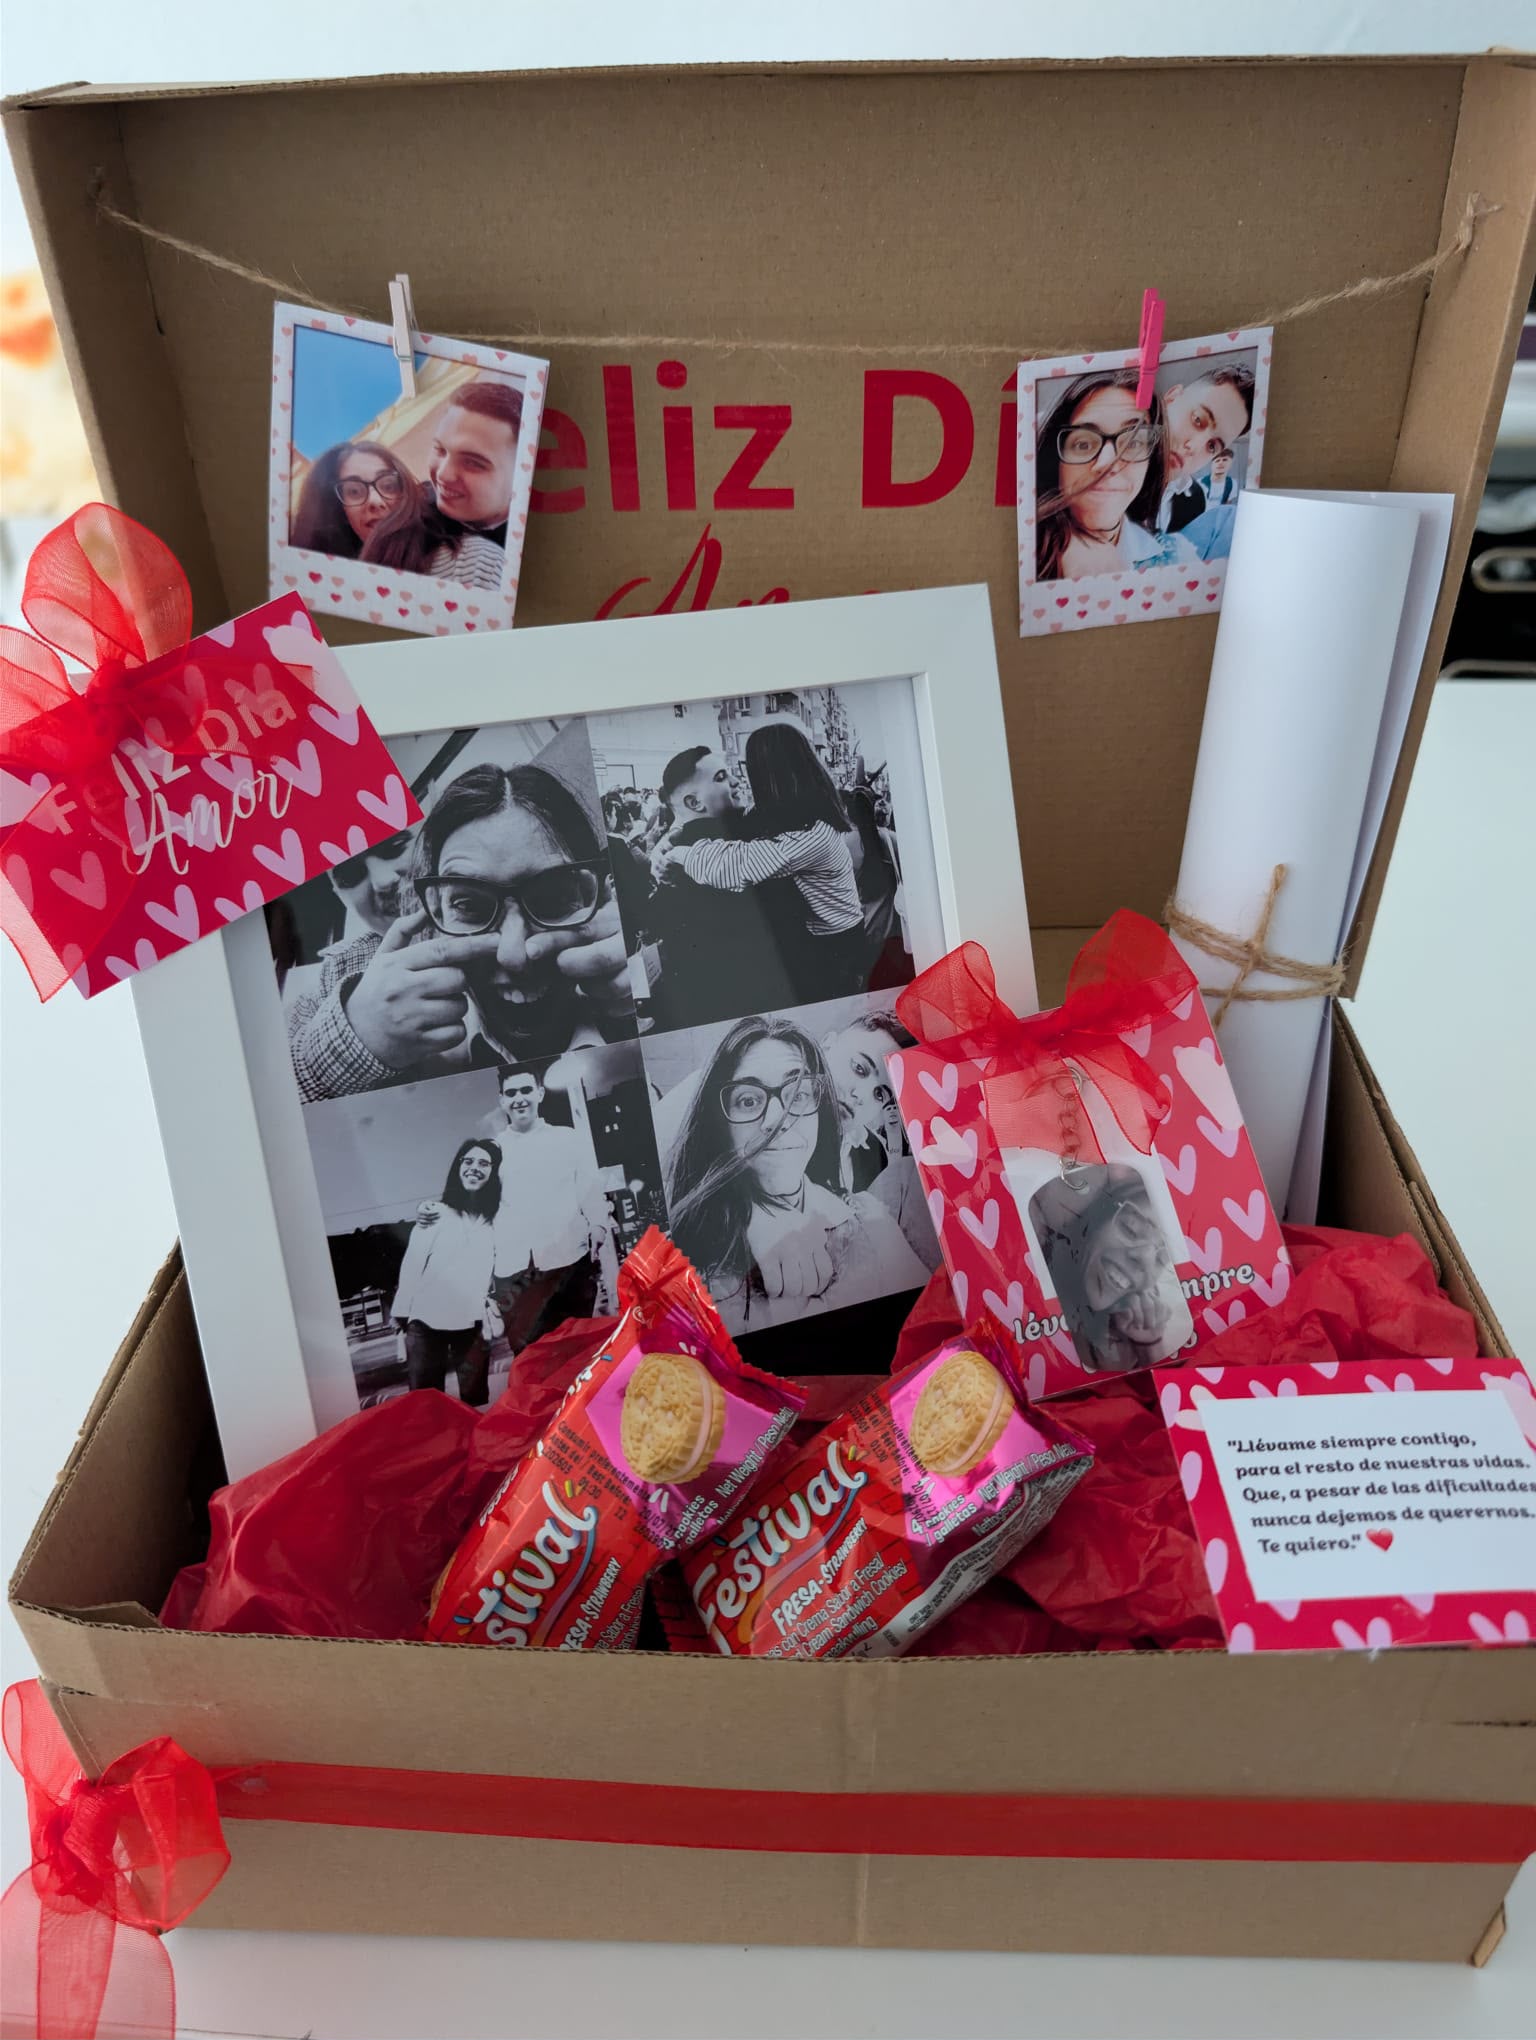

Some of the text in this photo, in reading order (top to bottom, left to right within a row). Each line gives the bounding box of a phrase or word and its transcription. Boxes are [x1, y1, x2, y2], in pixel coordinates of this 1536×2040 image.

[529, 360, 795, 514] eliz
[122, 770, 293, 876] Amor
[1320, 1434, 1398, 1452] siempre
[1400, 1431, 1477, 1448] contigo,
[715, 1478, 738, 1498] Net
[729, 1449, 763, 1483] Weight
[977, 1481, 1000, 1503] Net
[996, 1461, 1028, 1488] Weight
[1235, 1454, 1531, 1480] para el resto de nuestras vidas.
[1242, 1479, 1536, 1502] Que, a pesar de las dificultades
[911, 1518, 925, 1536] 4
[932, 1502, 978, 1544] galletas
[1251, 1506, 1536, 1528] nunca dejemos de querernos.
[472, 1481, 598, 1647] stival
[693, 1440, 869, 1656] Festival
[1258, 1538, 1281, 1554] Te
[797, 1608, 831, 1638] Crema
[800, 1626, 836, 1658] Cream
[829, 1589, 877, 1633] Sandwich
